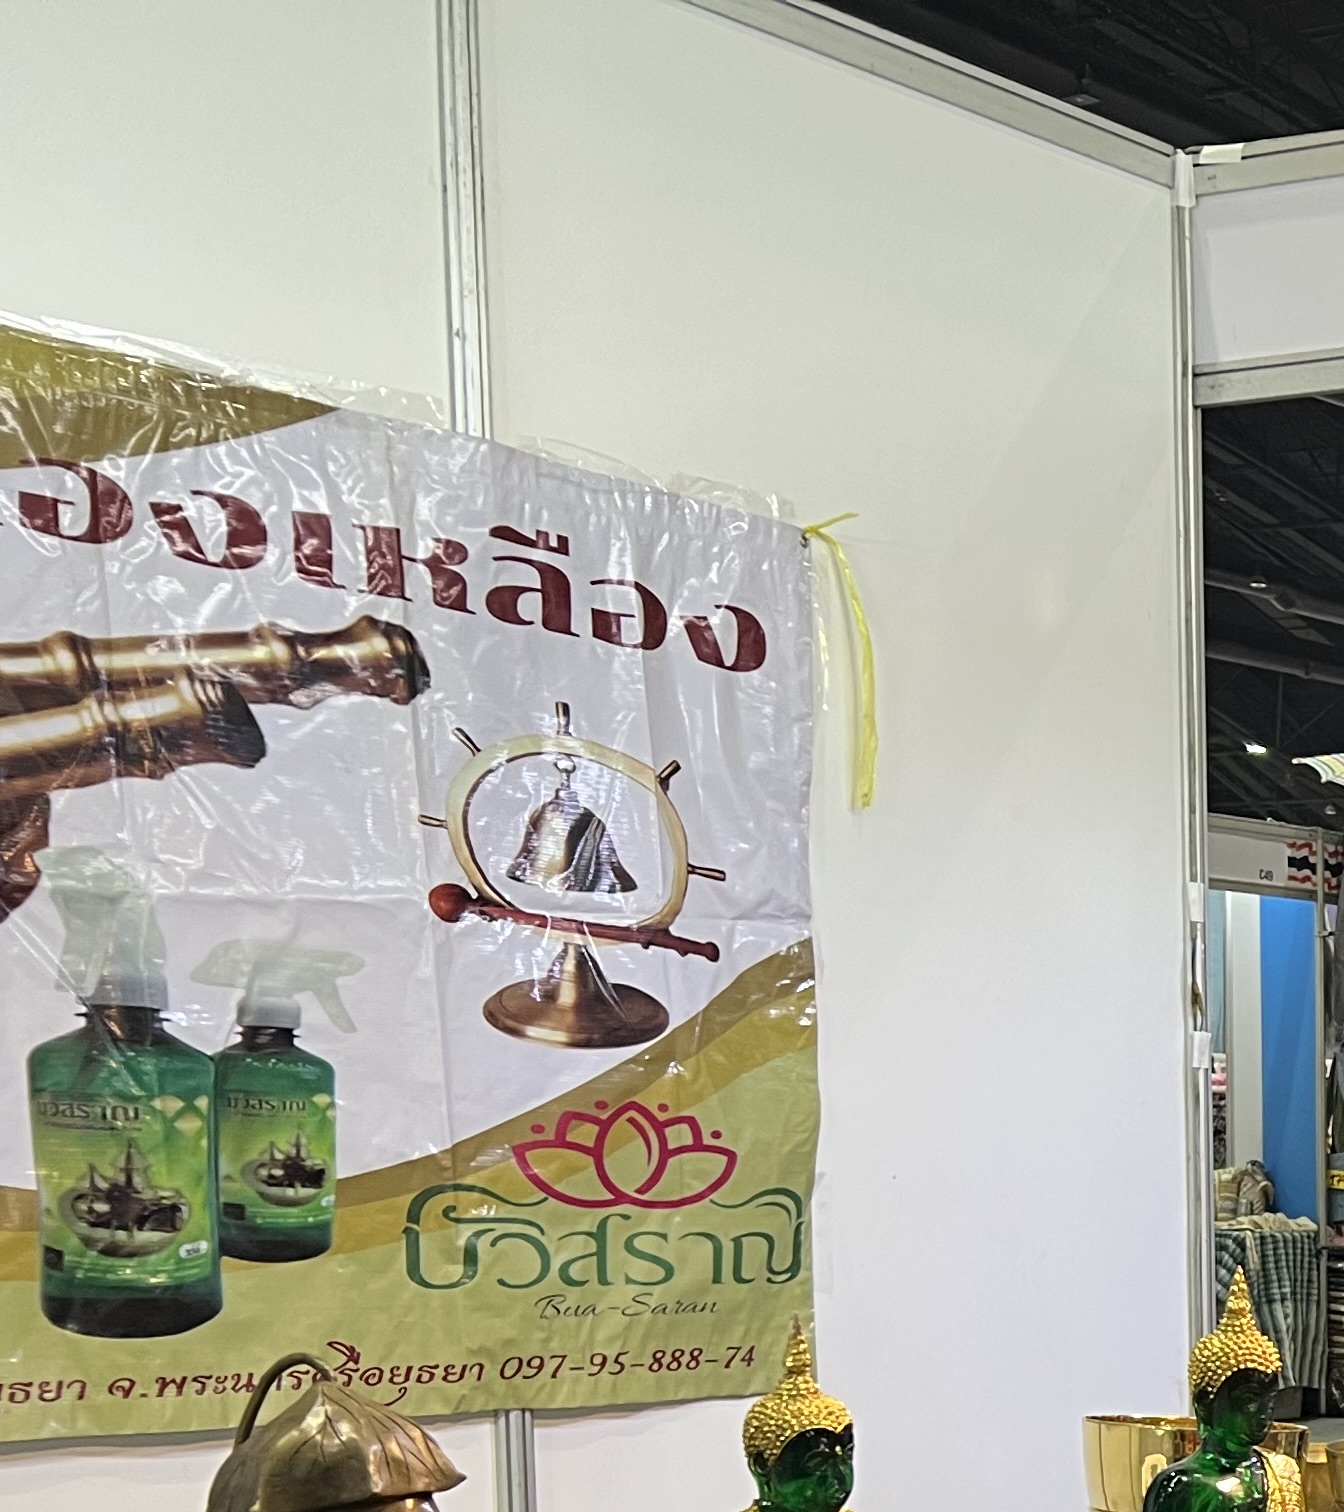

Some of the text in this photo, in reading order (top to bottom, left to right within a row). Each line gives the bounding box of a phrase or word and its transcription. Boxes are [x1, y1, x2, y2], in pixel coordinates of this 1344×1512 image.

[0, 457, 767, 673] องเหลือง
[0, 1340, 756, 1407] ธยา จ.พระนรรีอยุธยา 097-95-888-74
